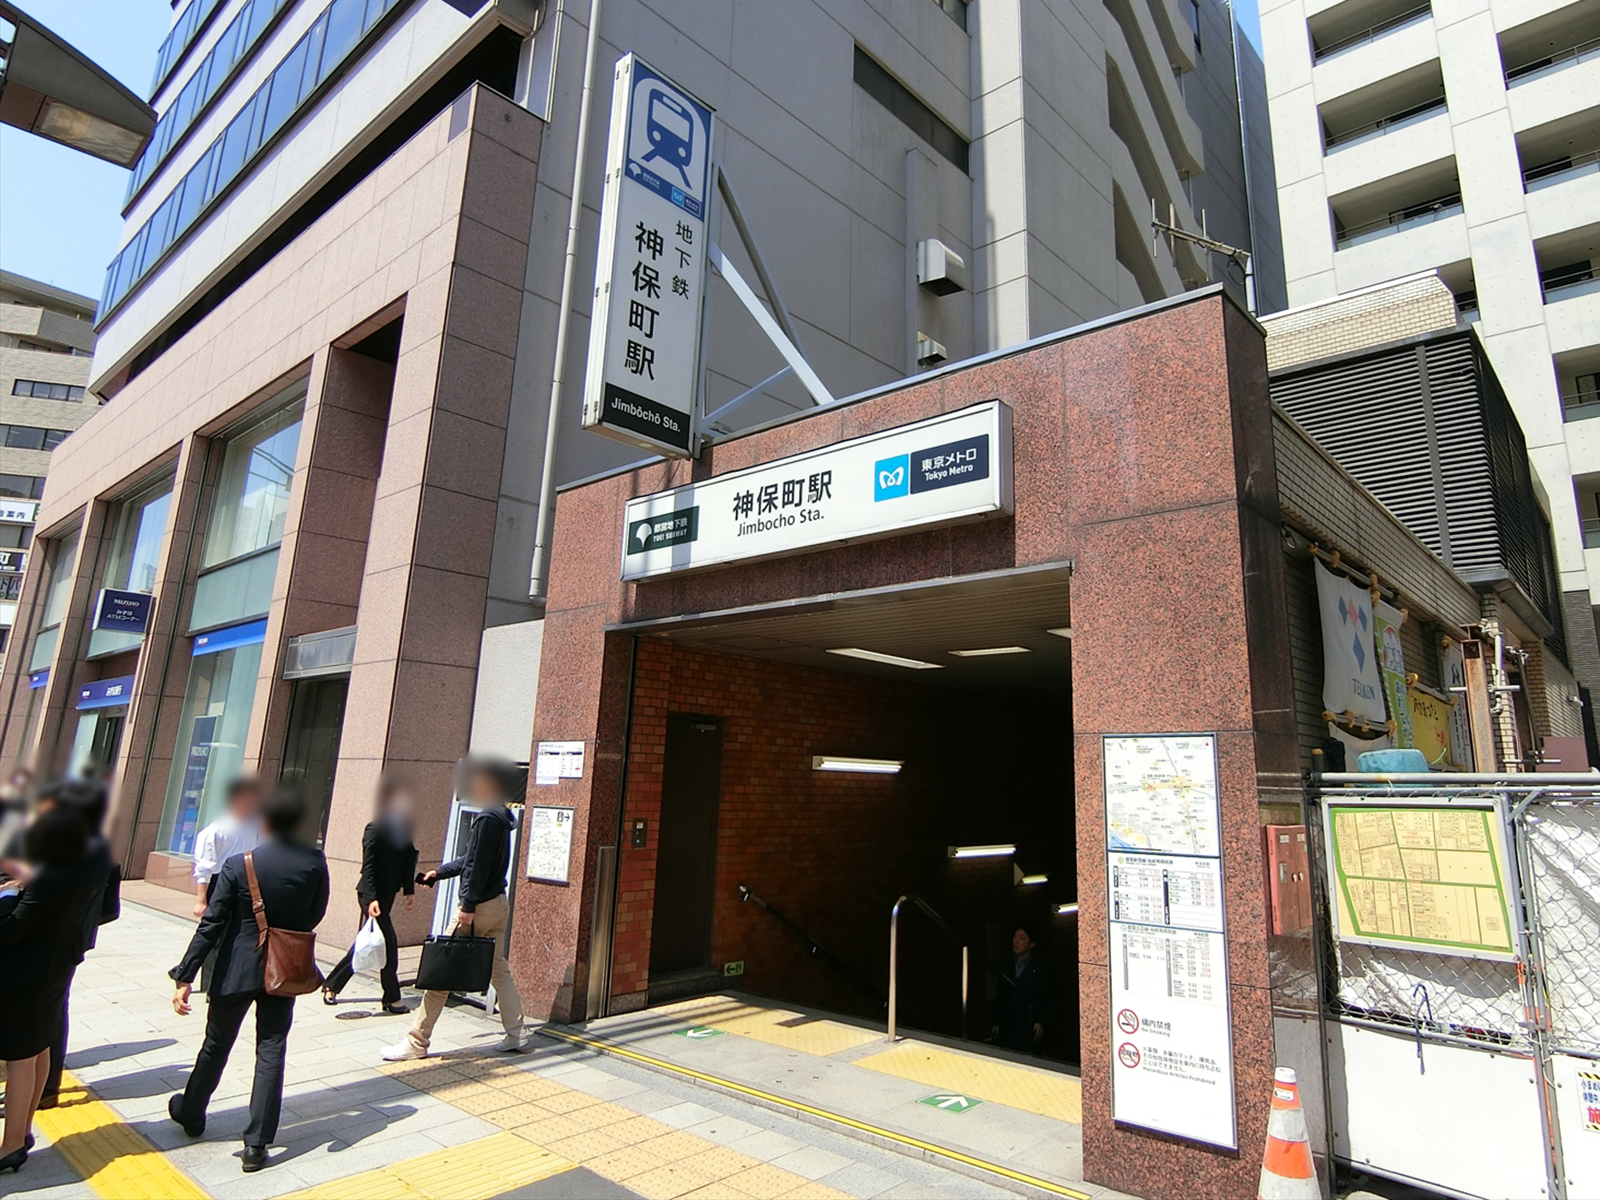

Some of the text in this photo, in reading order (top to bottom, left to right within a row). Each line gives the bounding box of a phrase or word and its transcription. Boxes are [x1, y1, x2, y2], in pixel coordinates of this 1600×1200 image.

[672, 220, 693, 300] 地下鉄
[624, 221, 664, 381] 神保町駅
[610, 397, 681, 433] Jimbōchō Sta.
[922, 448, 977, 472] 東京メトロ
[924, 464, 974, 481] Tokyo Metro
[732, 470, 832, 521] 神保町駅
[737, 509, 825, 537] Jimbocho Sta.
[113, 599, 140, 607] MIZUHO
